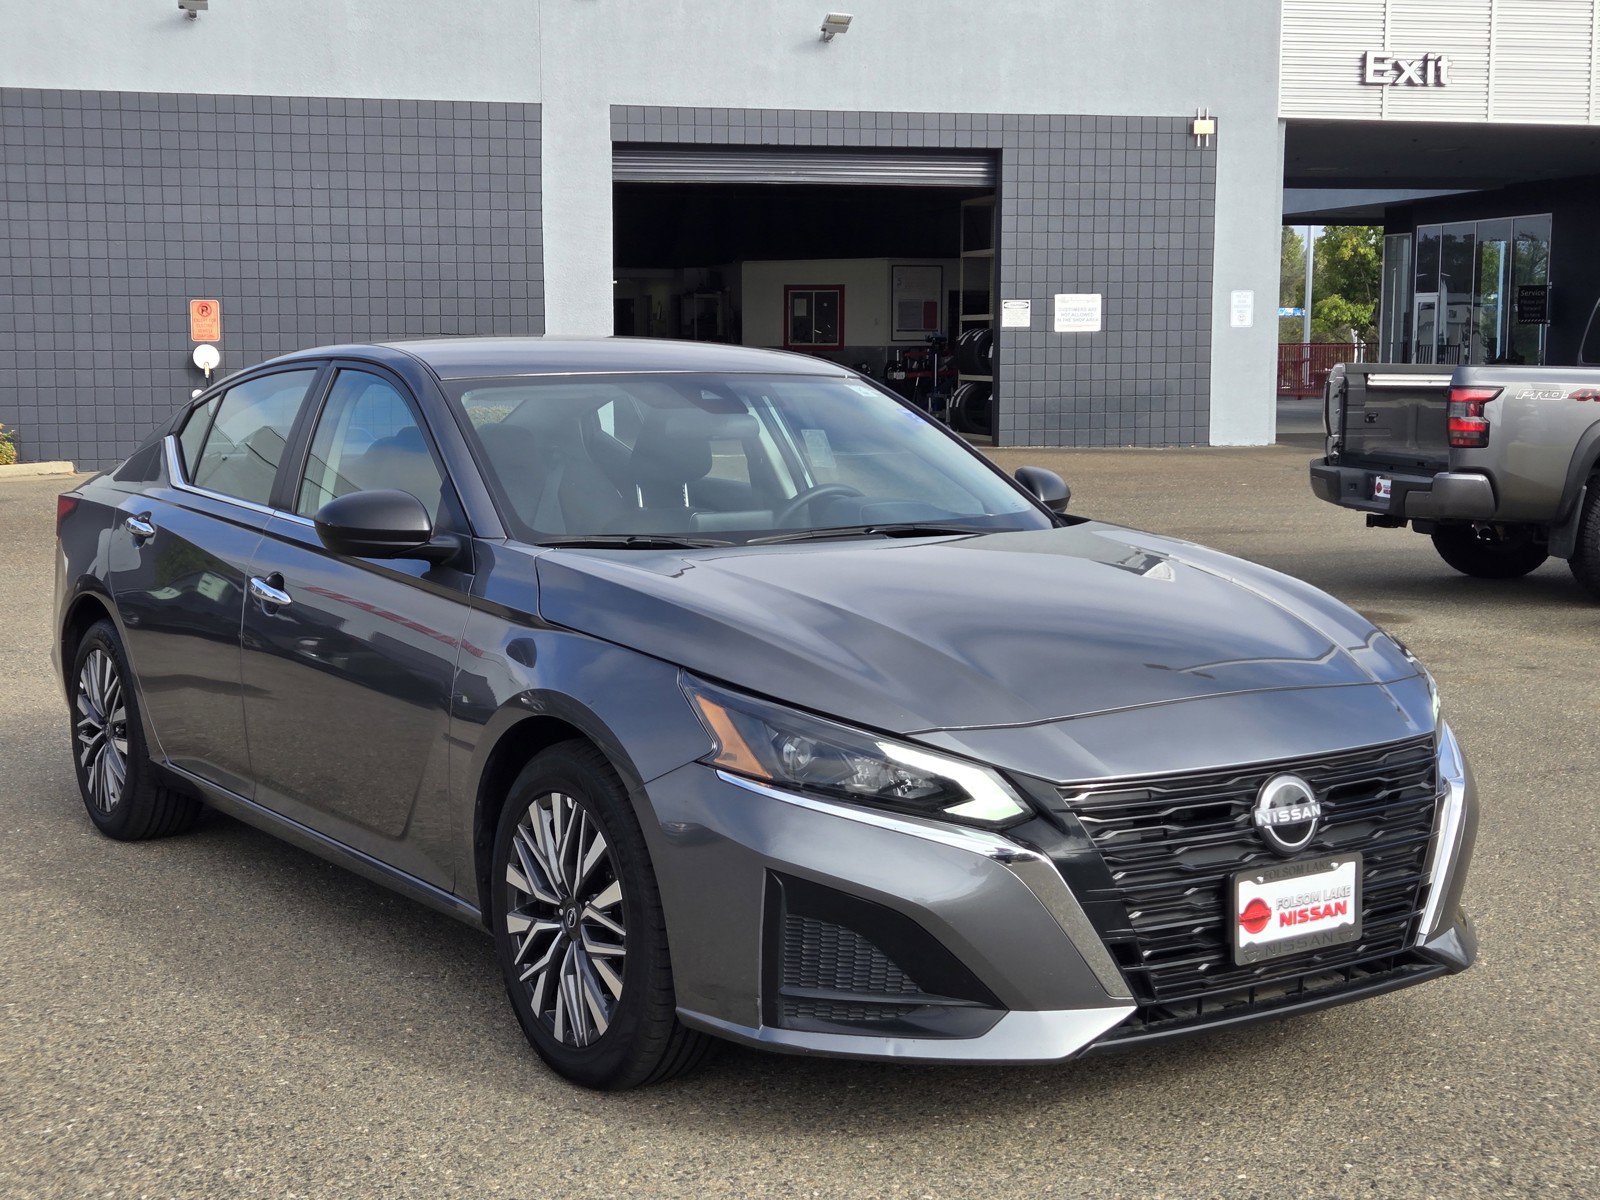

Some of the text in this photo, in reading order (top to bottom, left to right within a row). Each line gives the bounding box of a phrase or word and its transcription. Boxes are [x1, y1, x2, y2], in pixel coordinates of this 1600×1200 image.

[1363, 50, 1452, 85] Exit
[1520, 289, 1546, 297] Service
[1256, 803, 1321, 826] NISSAN
[1263, 864, 1304, 881] FOLSOM
[1276, 885, 1352, 910] FOLSOM LAKE
[1279, 899, 1348, 928] NISSAN
[1264, 931, 1334, 956] NISSAN
